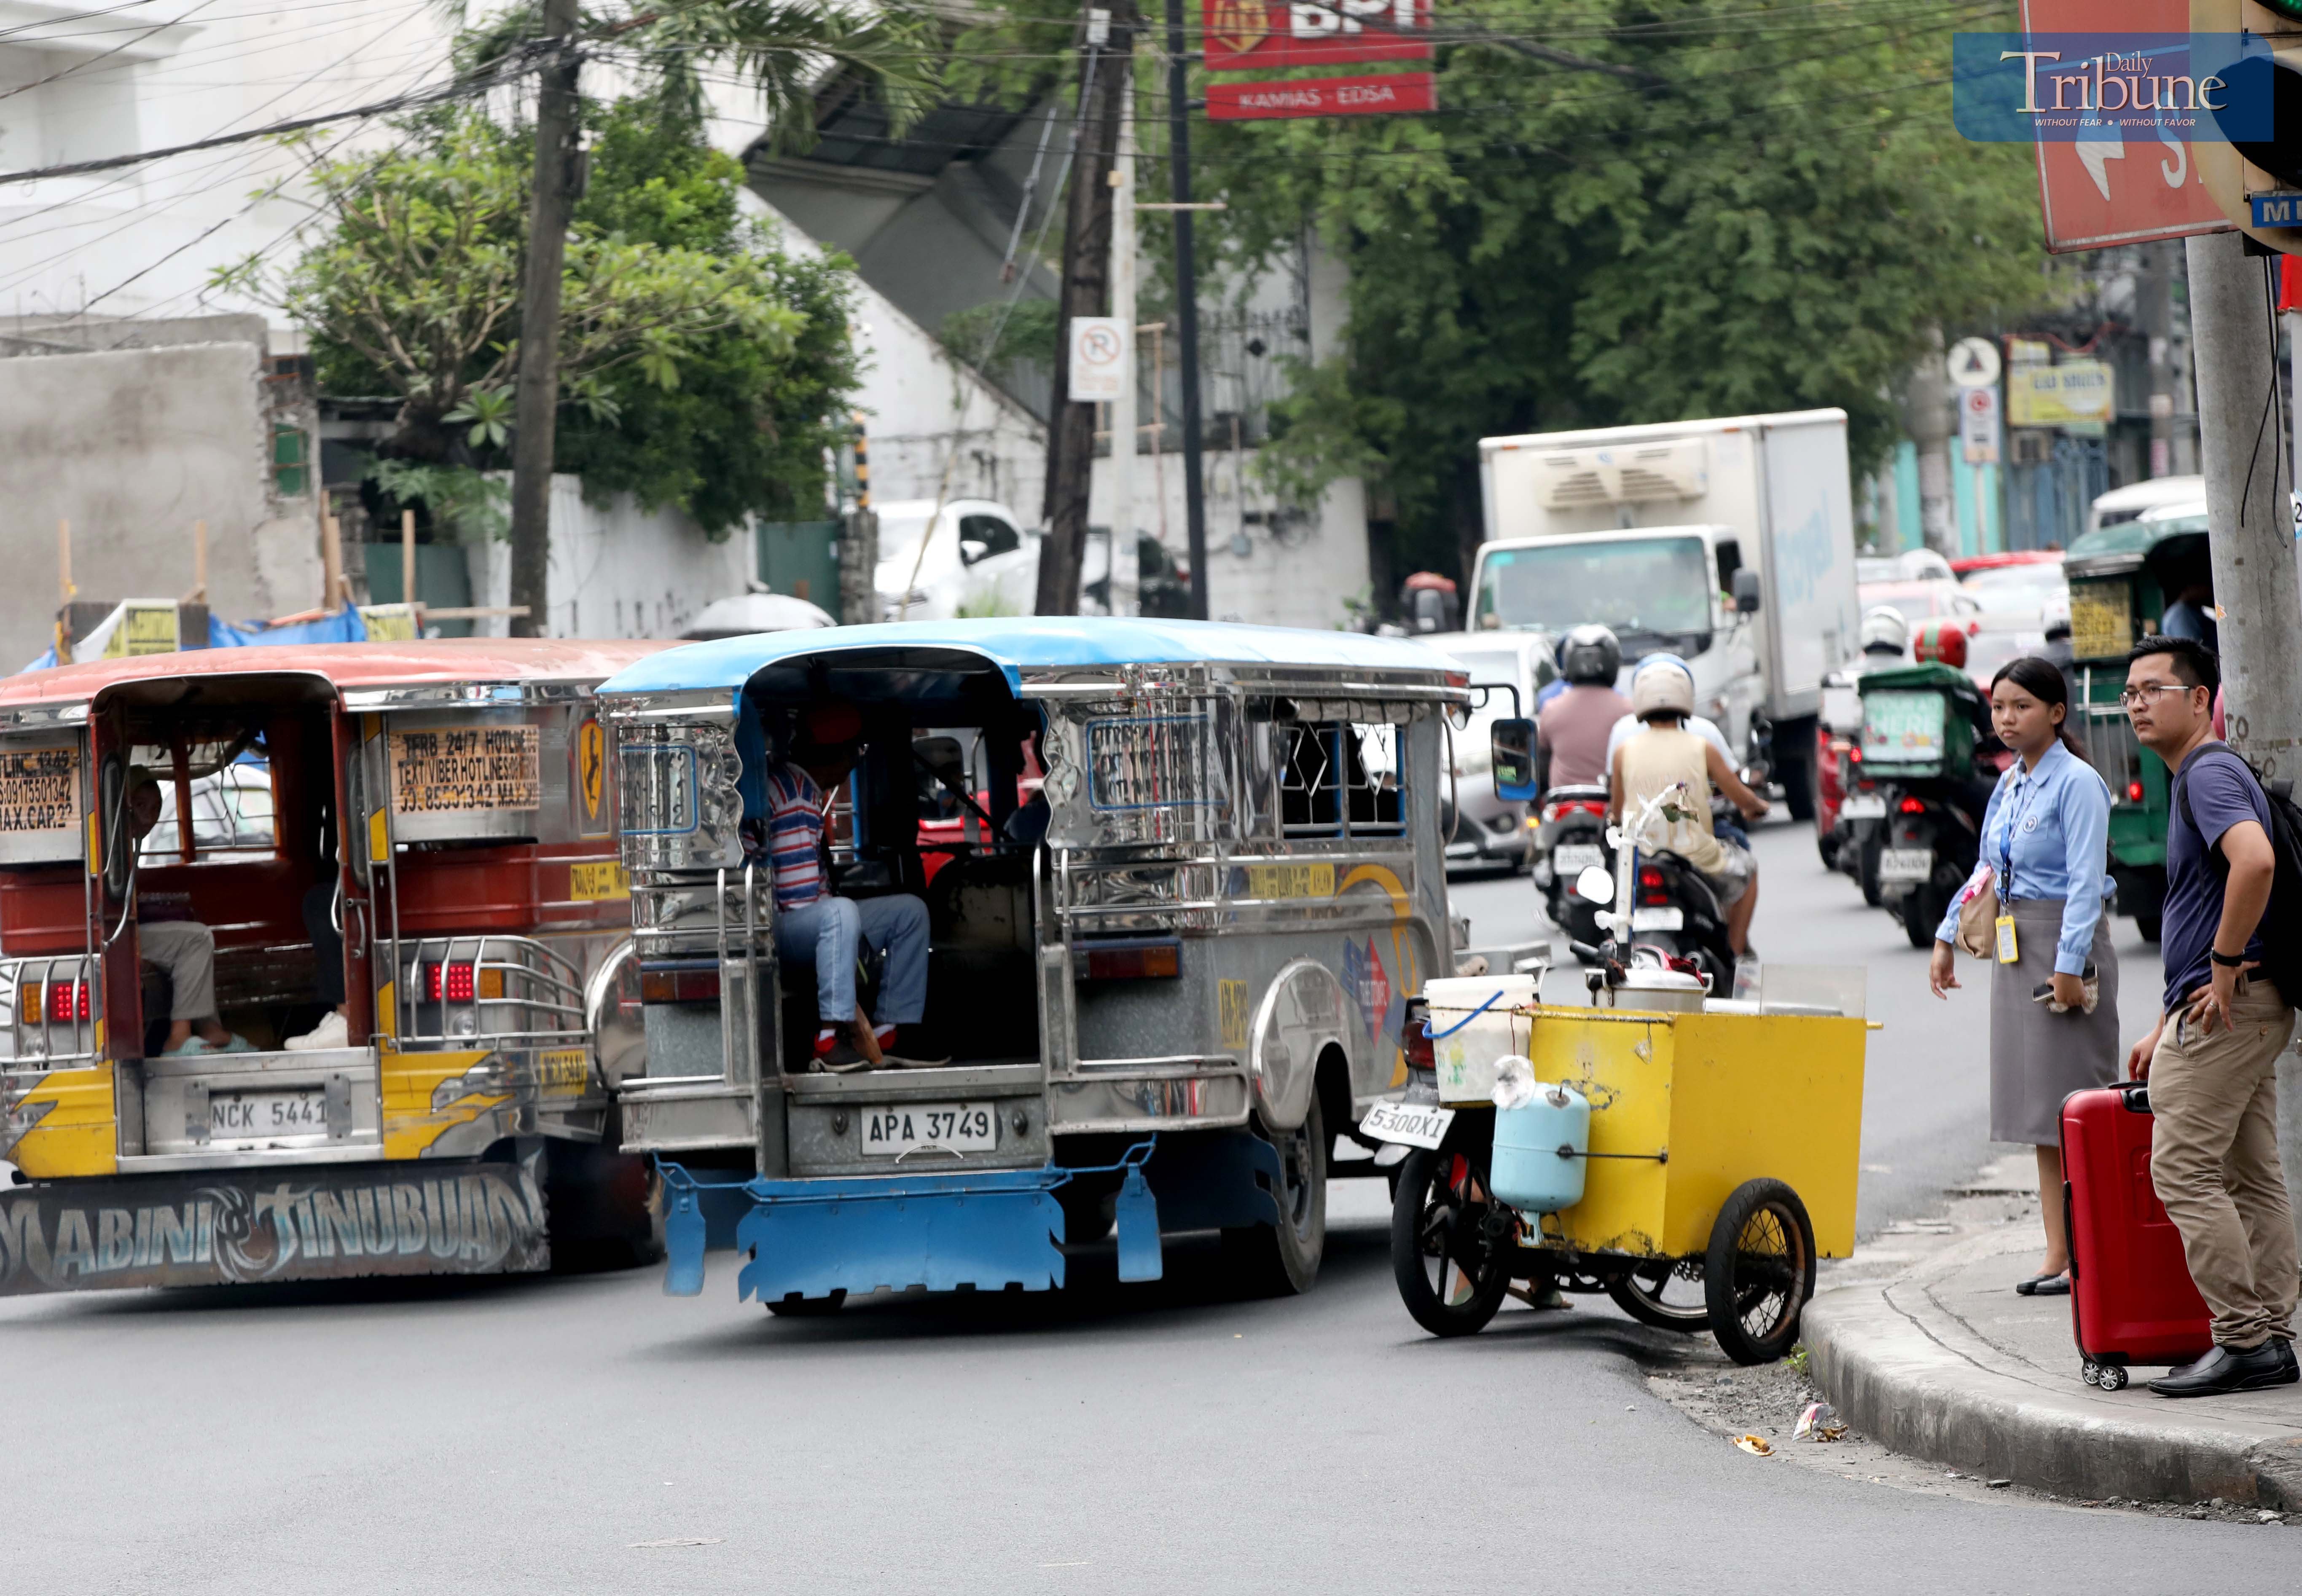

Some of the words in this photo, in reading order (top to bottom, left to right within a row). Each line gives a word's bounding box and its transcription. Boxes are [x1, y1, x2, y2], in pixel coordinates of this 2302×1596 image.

[1239, 89, 1321, 110] KAMIAS
[1337, 85, 1395, 105] EDSA
[446, 730, 477, 755] 24/7
[213, 1103, 253, 1128] NCK
[272, 1100, 327, 1125] 5441
[870, 1114, 914, 1141] APA
[927, 1111, 988, 1139] 3749
[1369, 1109, 1445, 1138] 530QXI
